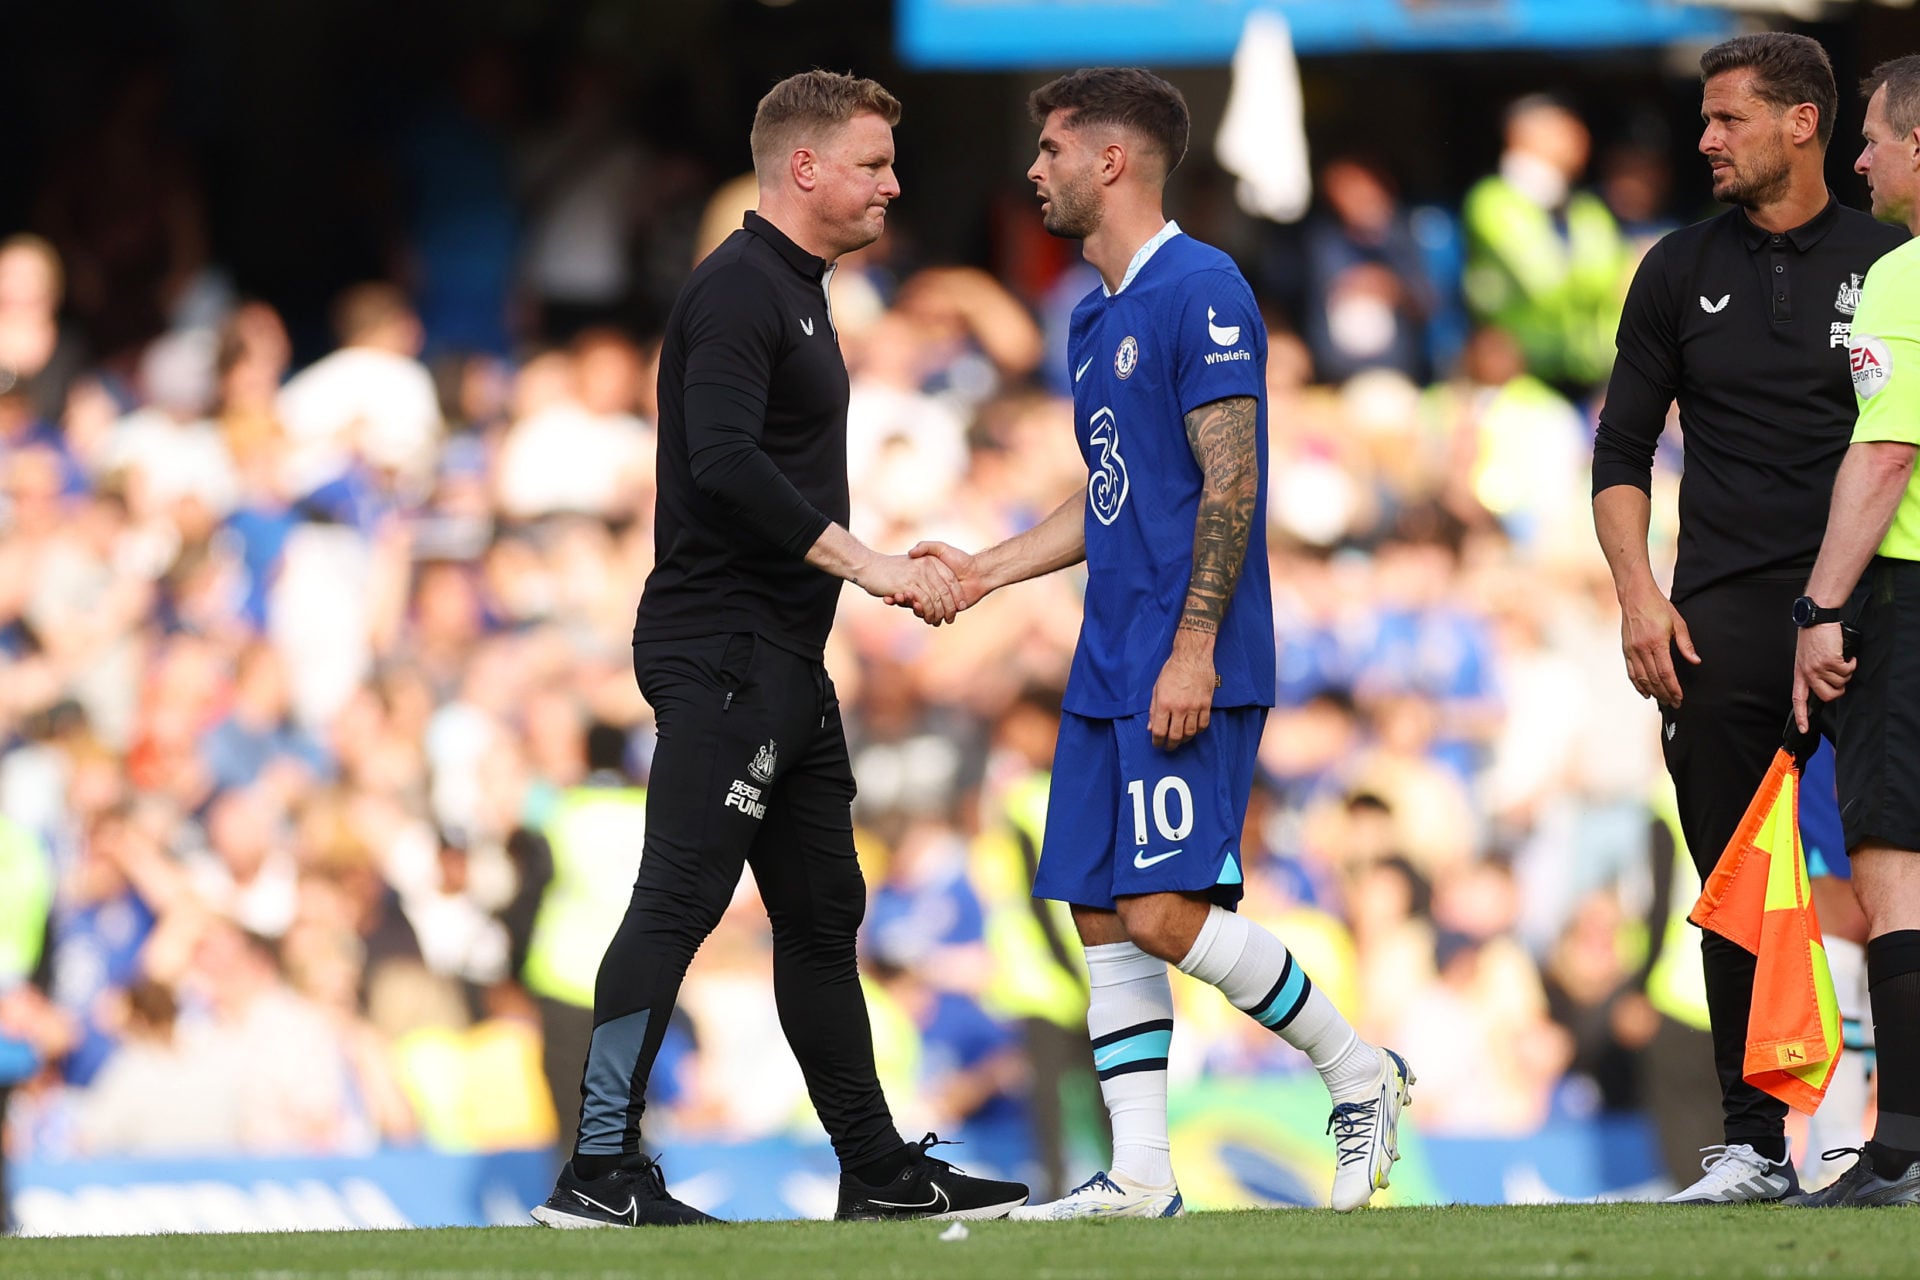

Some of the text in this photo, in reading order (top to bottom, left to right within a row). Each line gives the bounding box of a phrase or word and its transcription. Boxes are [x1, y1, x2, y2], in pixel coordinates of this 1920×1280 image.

[1204, 350, 1251, 365] WhaleFin
[1850, 347, 1881, 372] EA
[1852, 367, 1883, 384] SPORTS
[1127, 775, 1194, 846] 10
